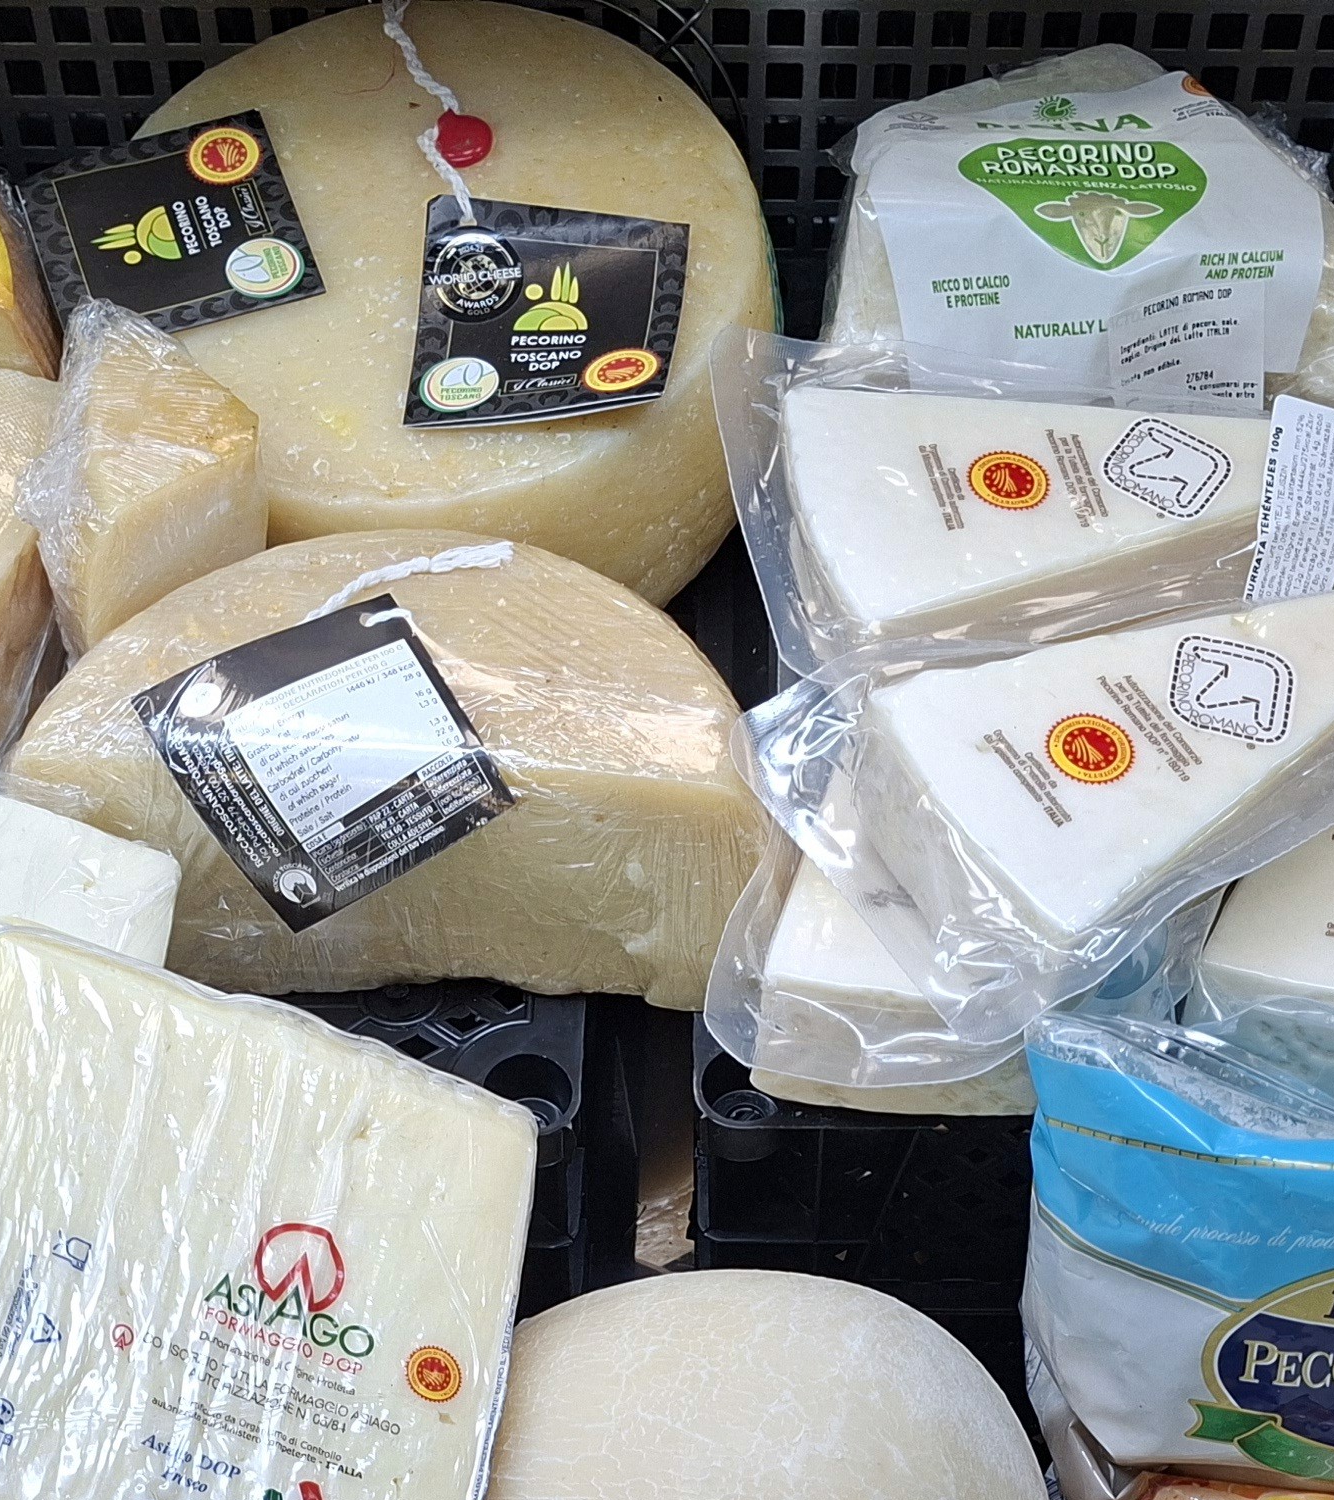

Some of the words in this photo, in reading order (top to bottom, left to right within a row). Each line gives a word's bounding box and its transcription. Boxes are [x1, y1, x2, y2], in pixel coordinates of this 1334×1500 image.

[997, 143, 1156, 164] PECORINO
[982, 161, 1110, 178] ROMANO
[1117, 163, 1178, 180] DOP
[977, 177, 1081, 188] NATURALMENTE
[1083, 181, 1128, 190] SENZA
[1131, 183, 1197, 192] LATTOSIO
[195, 195, 223, 248] TOSCANO
[214, 206, 231, 229] DOP
[172, 201, 201, 256] PECORINO
[1200, 253, 1221, 267] RICH
[1225, 252, 1237, 266] IN
[1241, 250, 1285, 265] CALCIUM
[429, 273, 478, 286] WORLD
[478, 267, 522, 282] CHEESE
[1205, 266, 1229, 280] AND
[1231, 265, 1274, 280] PROTEIN
[932, 277, 960, 293] RICCO
[962, 278, 974, 290] DI
[975, 275, 1010, 289] CALCIO
[456, 293, 500, 309] AWARDS
[954, 292, 1000, 307] PROTEINE
[1143, 296, 1179, 317] PECORINO
[1182, 289, 1214, 304] ROMANO
[1217, 287, 1233, 300] DOP
[467, 307, 491, 316] GOLD
[510, 334, 587, 347] PECORINO
[1014, 321, 1097, 340] NATURALLY
[509, 350, 582, 363] TOSCANO
[528, 361, 560, 372] DOP
[1111, 429, 1147, 474] PECORINO
[1116, 473, 1175, 509] ROMANO
[1245, 541, 1267, 601] BURRATA
[1261, 457, 1277, 540] TEHÉNTEJES
[1270, 427, 1283, 453] 100g
[1175, 651, 1196, 712] PECORINO
[1188, 709, 1259, 736] ROMANO
[203, 1272, 375, 1358] ASIAGO
[205, 1306, 313, 1360] FORMAGGIO
[321, 1352, 364, 1375] DOP
[199, 1450, 242, 1481] DOP
